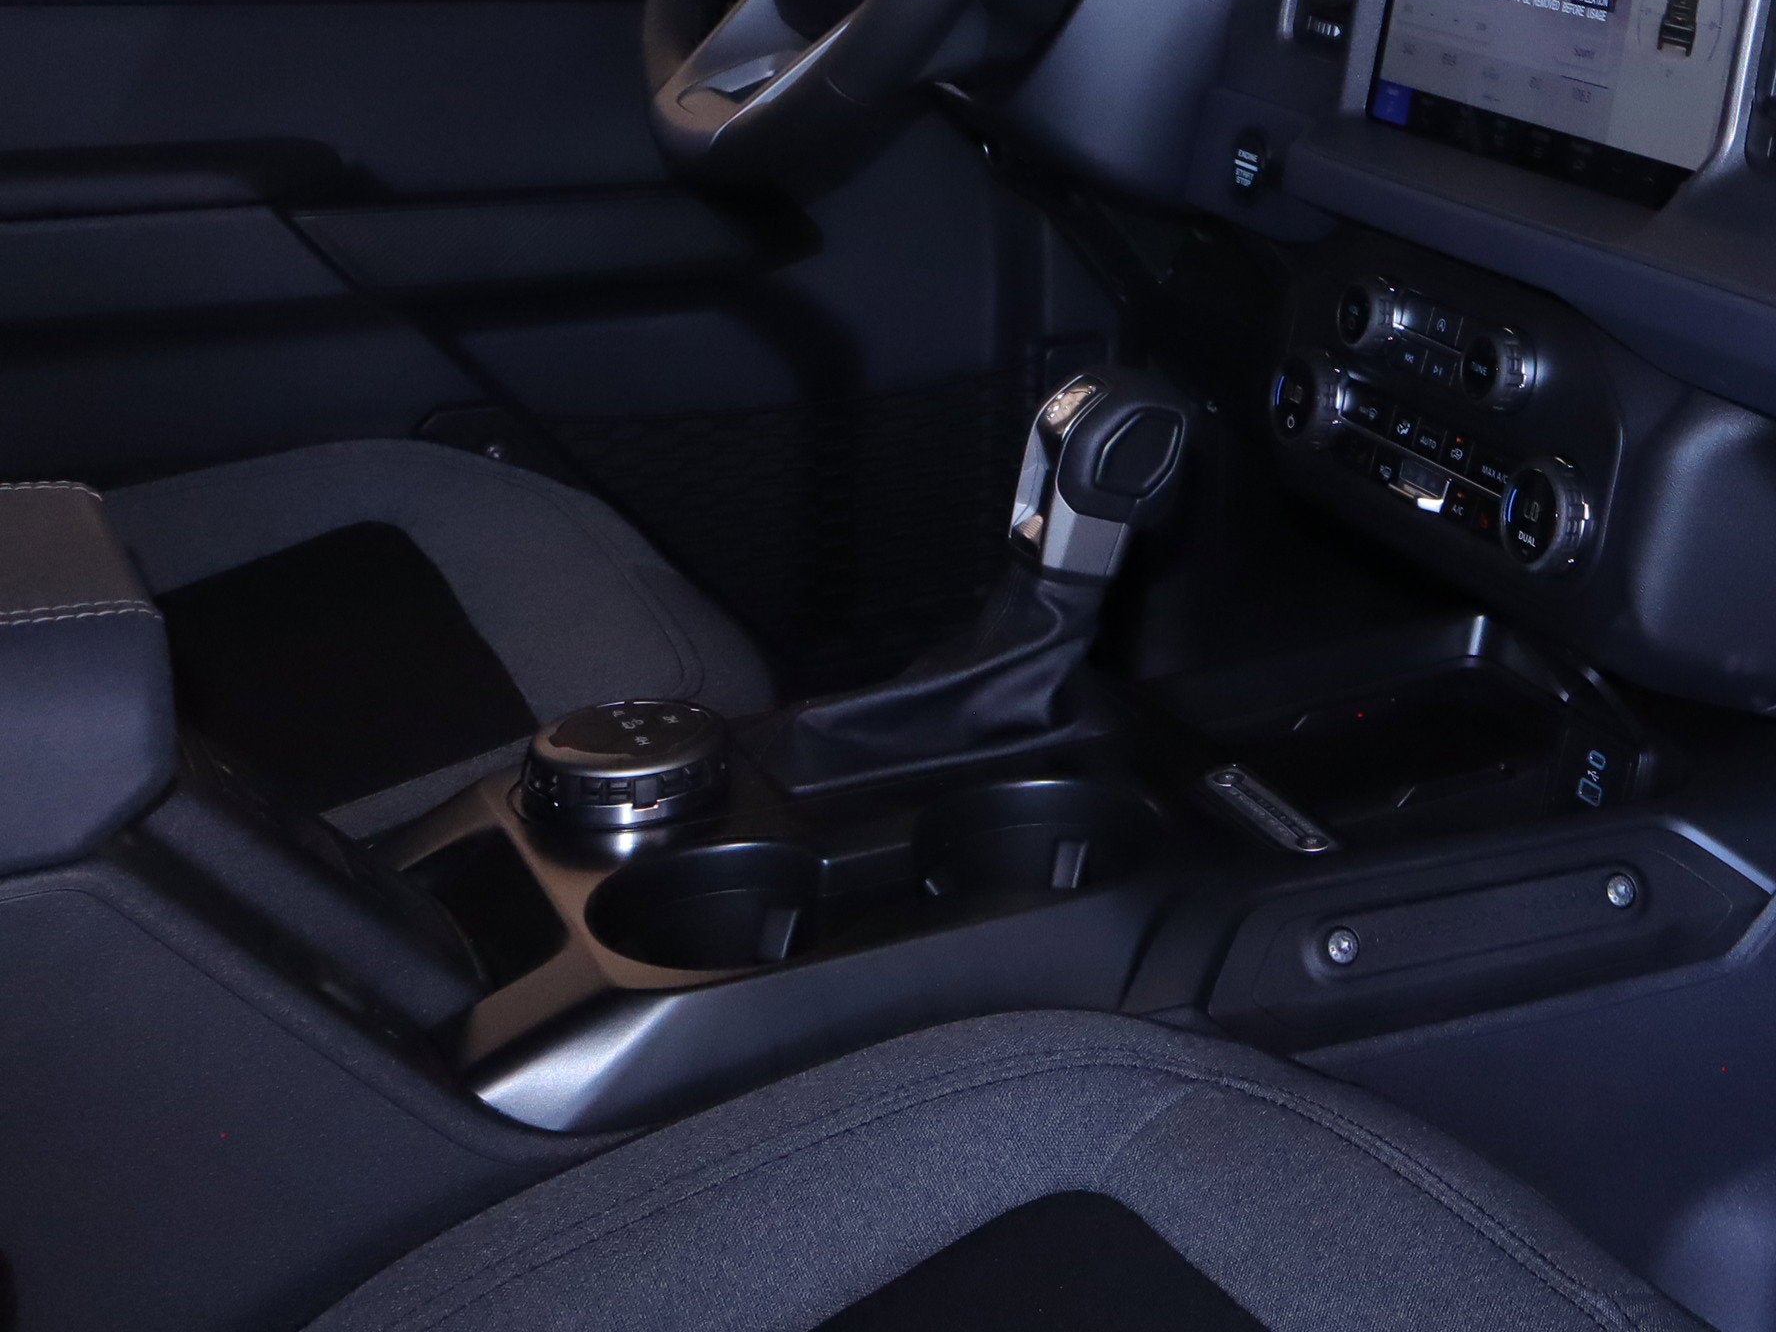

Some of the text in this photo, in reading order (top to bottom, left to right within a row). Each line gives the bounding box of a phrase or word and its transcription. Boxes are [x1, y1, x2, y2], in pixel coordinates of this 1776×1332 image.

[1562, 2, 1586, 18] BEFORE
[1587, 8, 1608, 22] USAGE
[1419, 435, 1437, 450] AUTO
[1481, 465, 1510, 484] MAX A/C
[1452, 504, 1465, 516] A/C
[1518, 530, 1537, 548] DUAL
